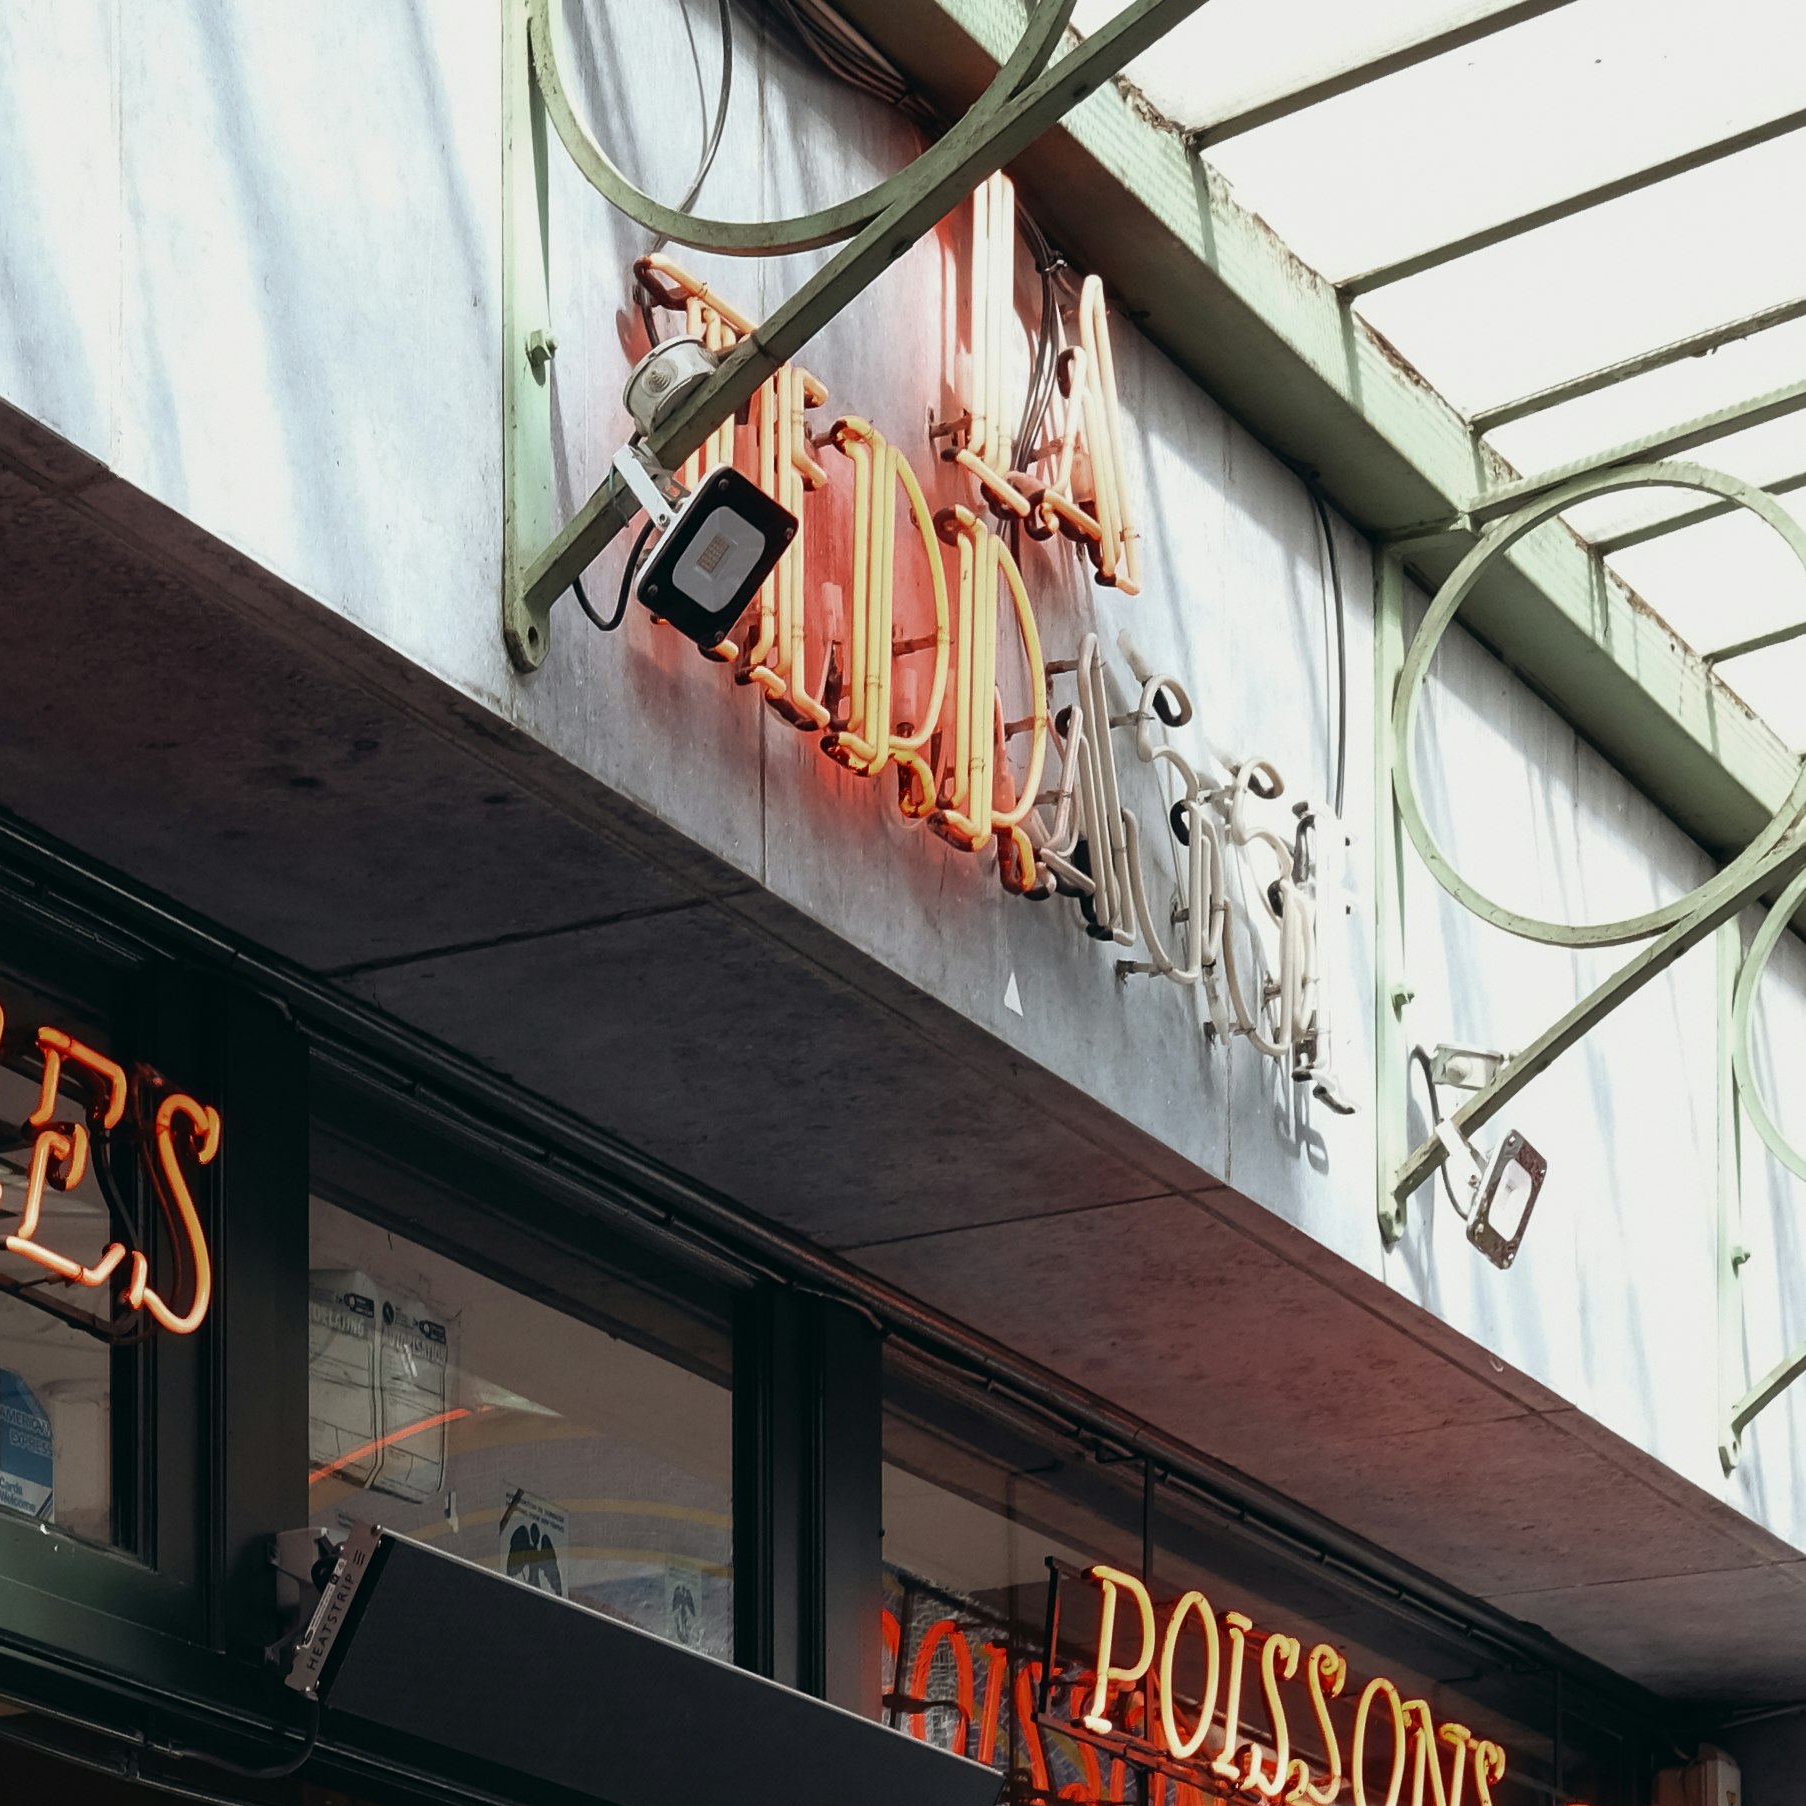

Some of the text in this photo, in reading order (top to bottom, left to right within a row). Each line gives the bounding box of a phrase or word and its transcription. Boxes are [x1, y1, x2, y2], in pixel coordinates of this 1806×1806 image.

[0, 1405, 52, 1437] AMERICAN
[9, 1428, 53, 1456] EXPRESS
[306, 1572, 356, 1671] HEATSTRIP
